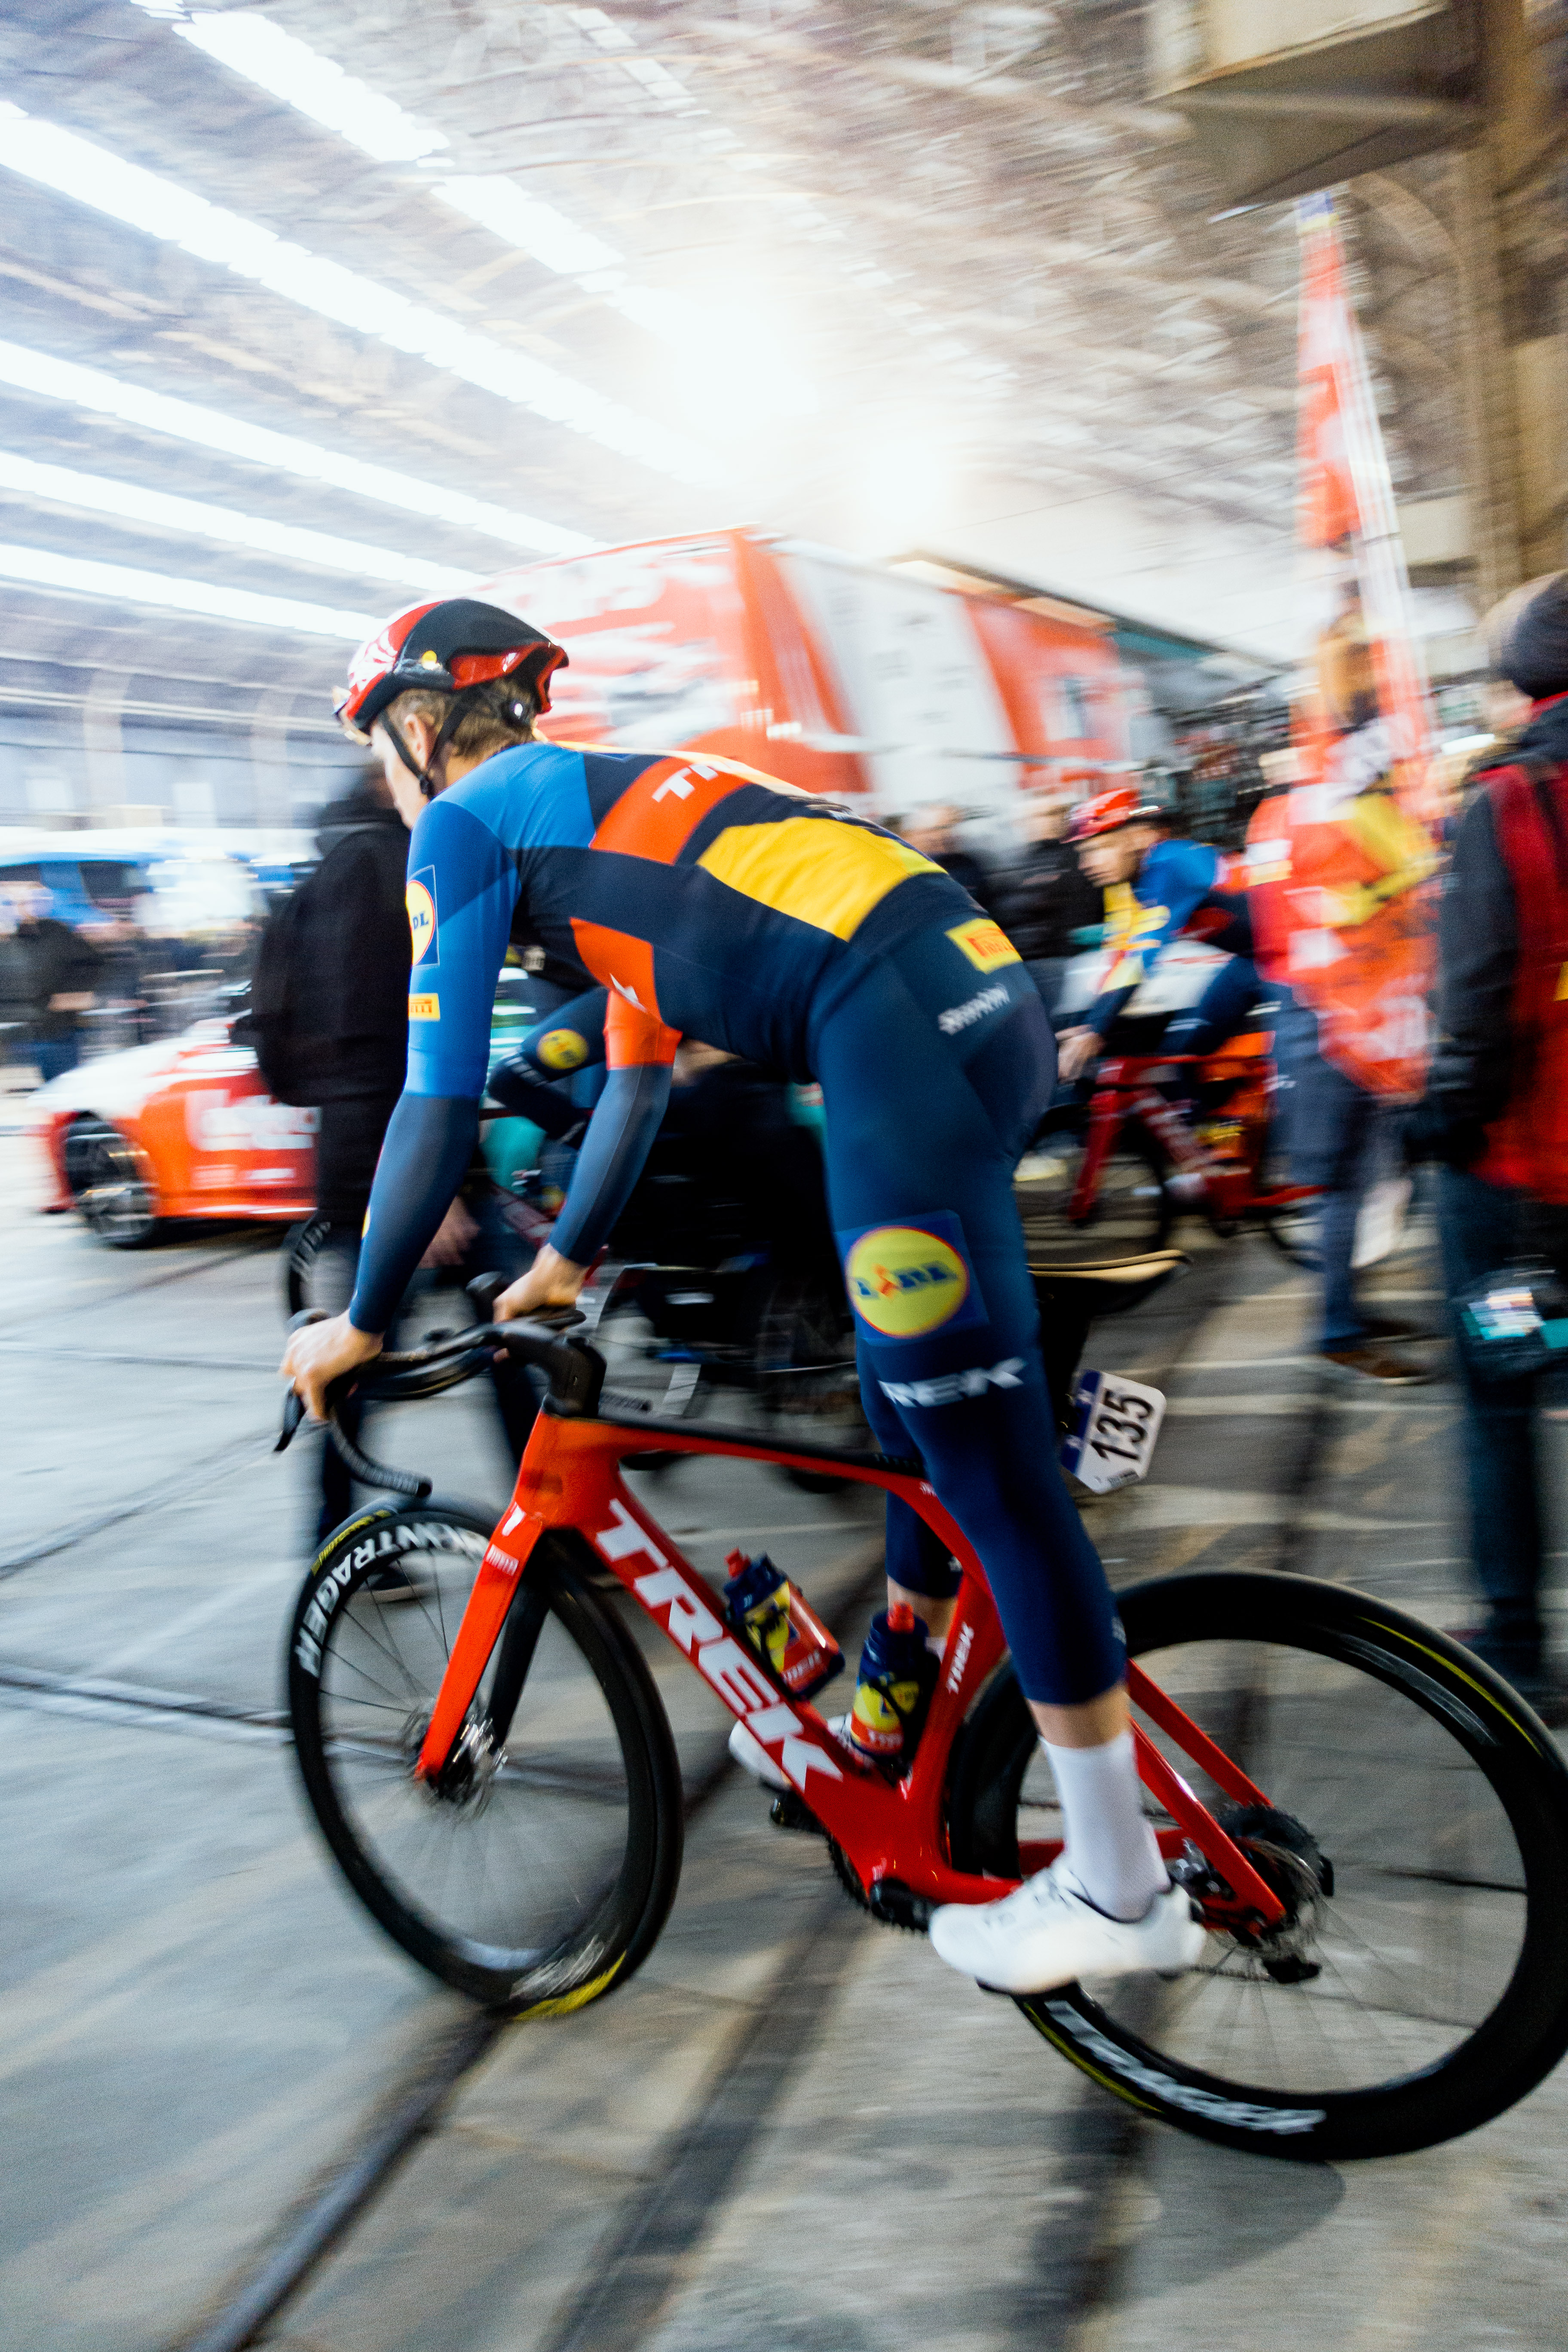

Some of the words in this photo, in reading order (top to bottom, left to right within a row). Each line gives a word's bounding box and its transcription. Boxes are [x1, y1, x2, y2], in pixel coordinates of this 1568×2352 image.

[412, 912, 429, 930] DL
[877, 1357, 1028, 1408] REK
[1090, 1387, 1155, 1461] 135
[596, 1498, 844, 1792] TREK
